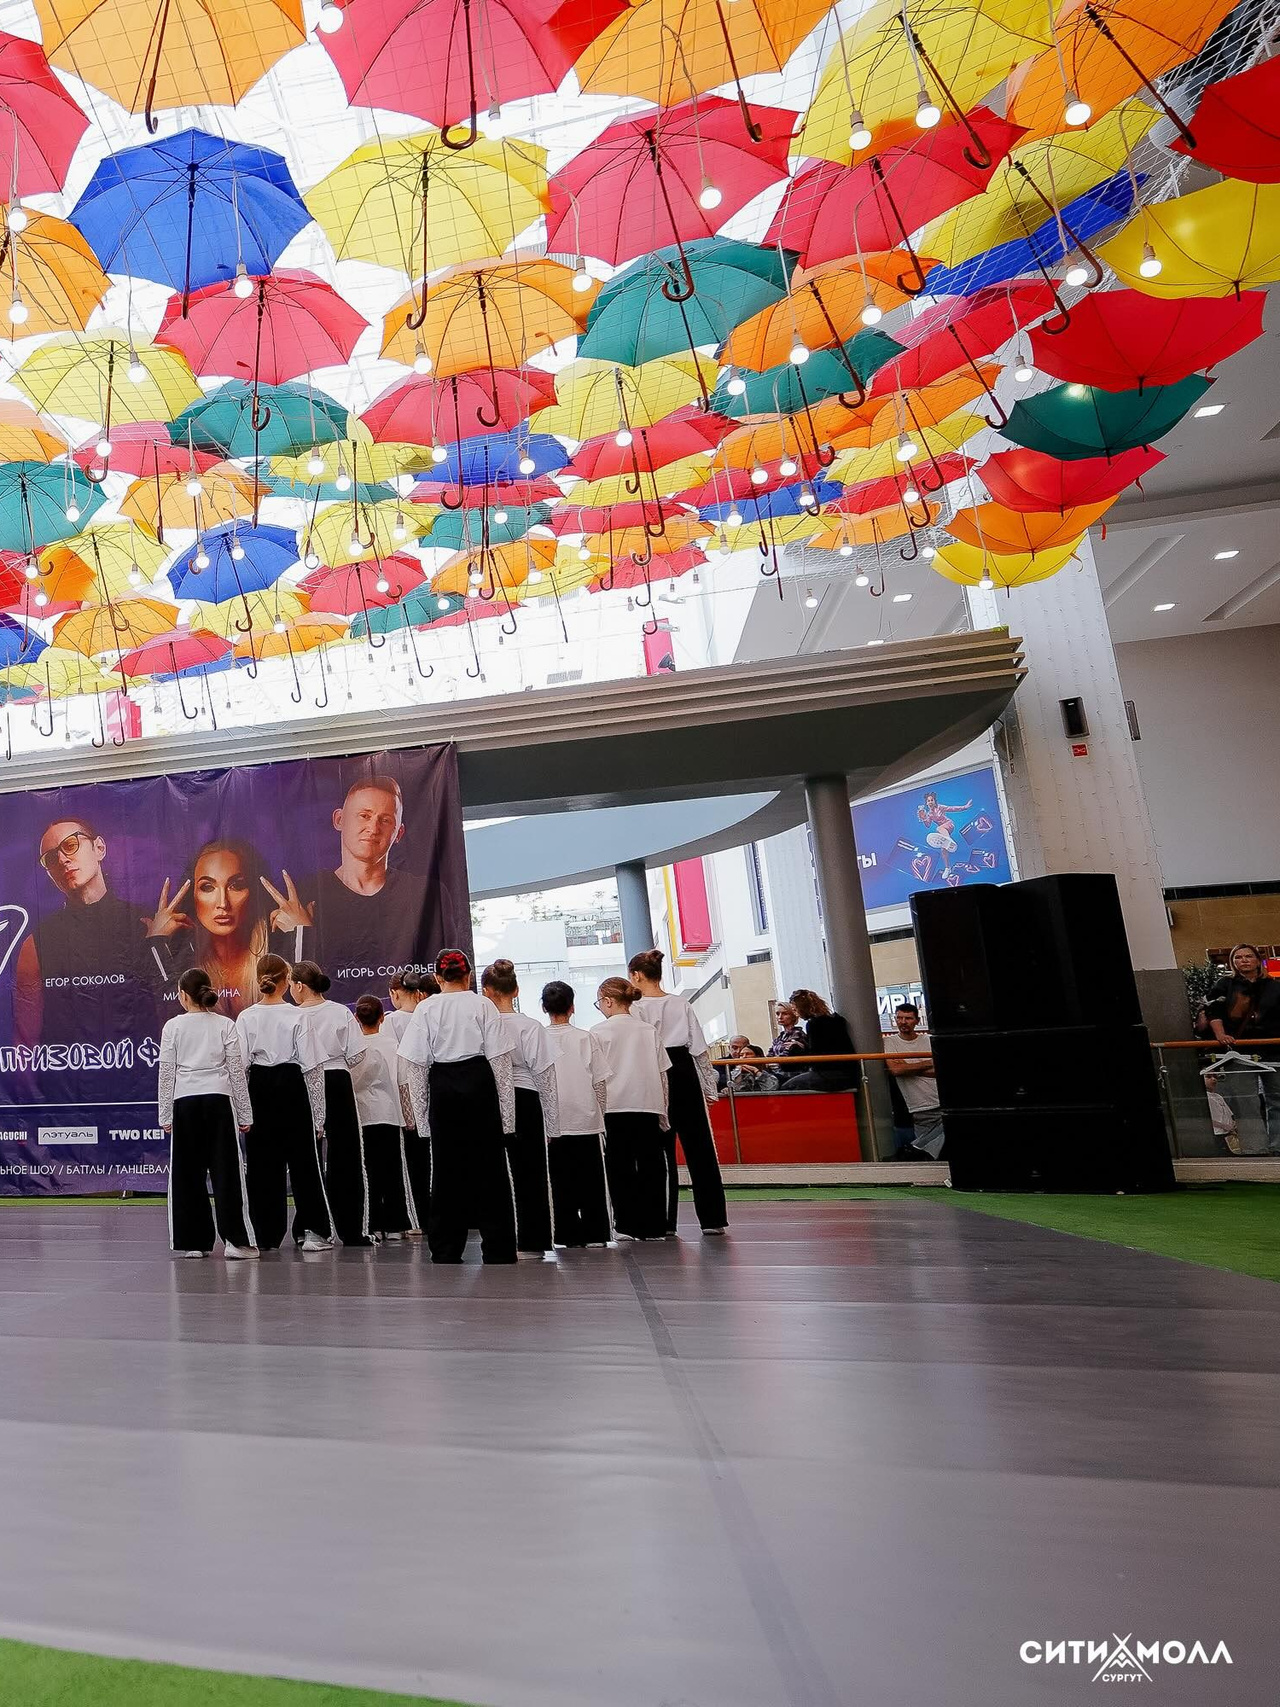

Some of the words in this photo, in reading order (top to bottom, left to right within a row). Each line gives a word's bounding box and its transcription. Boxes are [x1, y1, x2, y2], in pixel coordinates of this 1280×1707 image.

[337, 967, 375, 979] ИГОРЬ
[45, 978, 70, 988] ЕГОР
[72, 973, 125, 986] СОКОЛОВ
[108, 1129, 140, 1141] TWO
[30, 1165, 57, 1175] ШОУ
[66, 1164, 105, 1175] БАТТЛЫ
[116, 1164, 170, 1175] ТАНЦЕВАЛ
